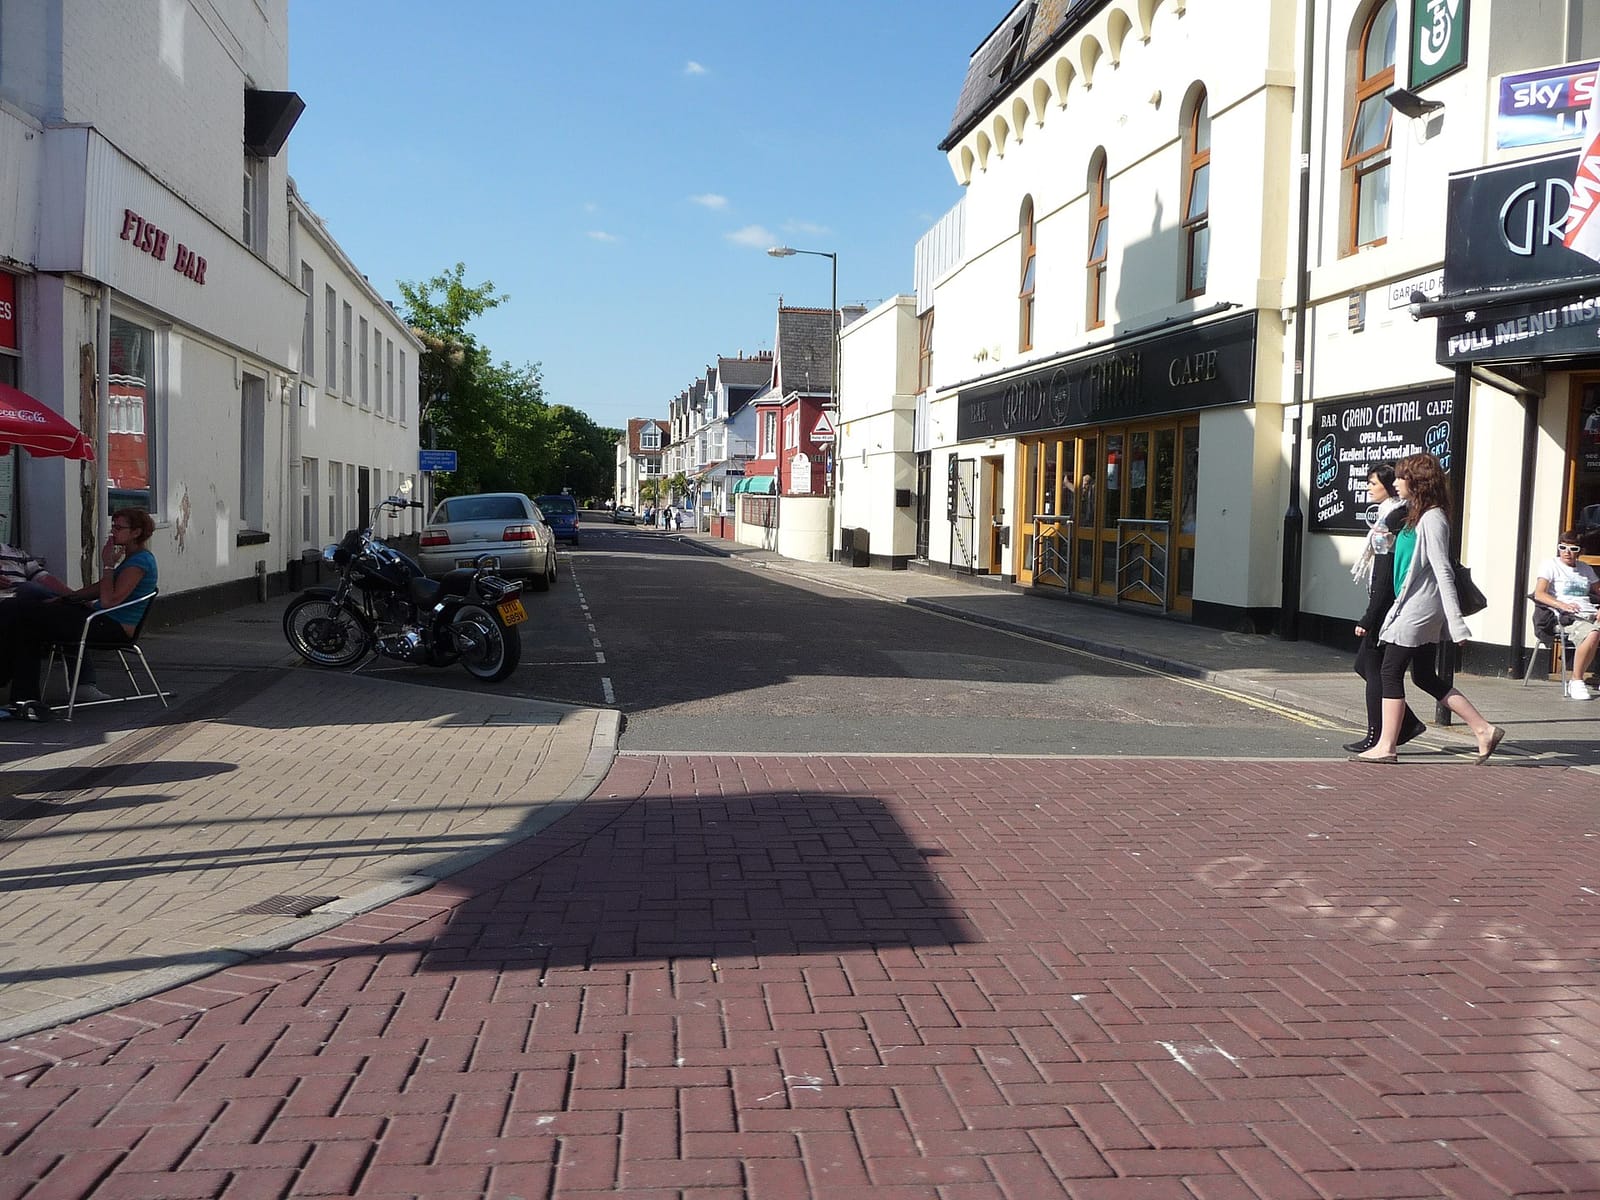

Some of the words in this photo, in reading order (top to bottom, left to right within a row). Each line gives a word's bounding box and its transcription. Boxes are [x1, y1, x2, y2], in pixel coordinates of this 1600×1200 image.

[1514, 82, 1564, 108] sky
[120, 209, 169, 261] FISH
[173, 243, 207, 285] BAR
[1392, 278, 1436, 301] GARFIELD
[1448, 328, 1493, 357] FULL
[1495, 309, 1557, 346] MENU
[1169, 350, 1218, 386] CAFE
[1321, 414, 1337, 428] BAR
[1342, 407, 1373, 431] GRAND
[1376, 400, 1422, 428] CENTRAL
[1426, 400, 1453, 416] CAFE
[1360, 432, 1376, 444] OPEN
[1429, 426, 1447, 445] LIVE
[1340, 447, 1366, 462] Excellent
[1366, 445, 1382, 461] Food
[1382, 444, 1402, 460] Served
[1402, 444, 1410, 458] all
[1317, 465, 1336, 486] SPORT
[1317, 500, 1345, 523] SPECIALS
